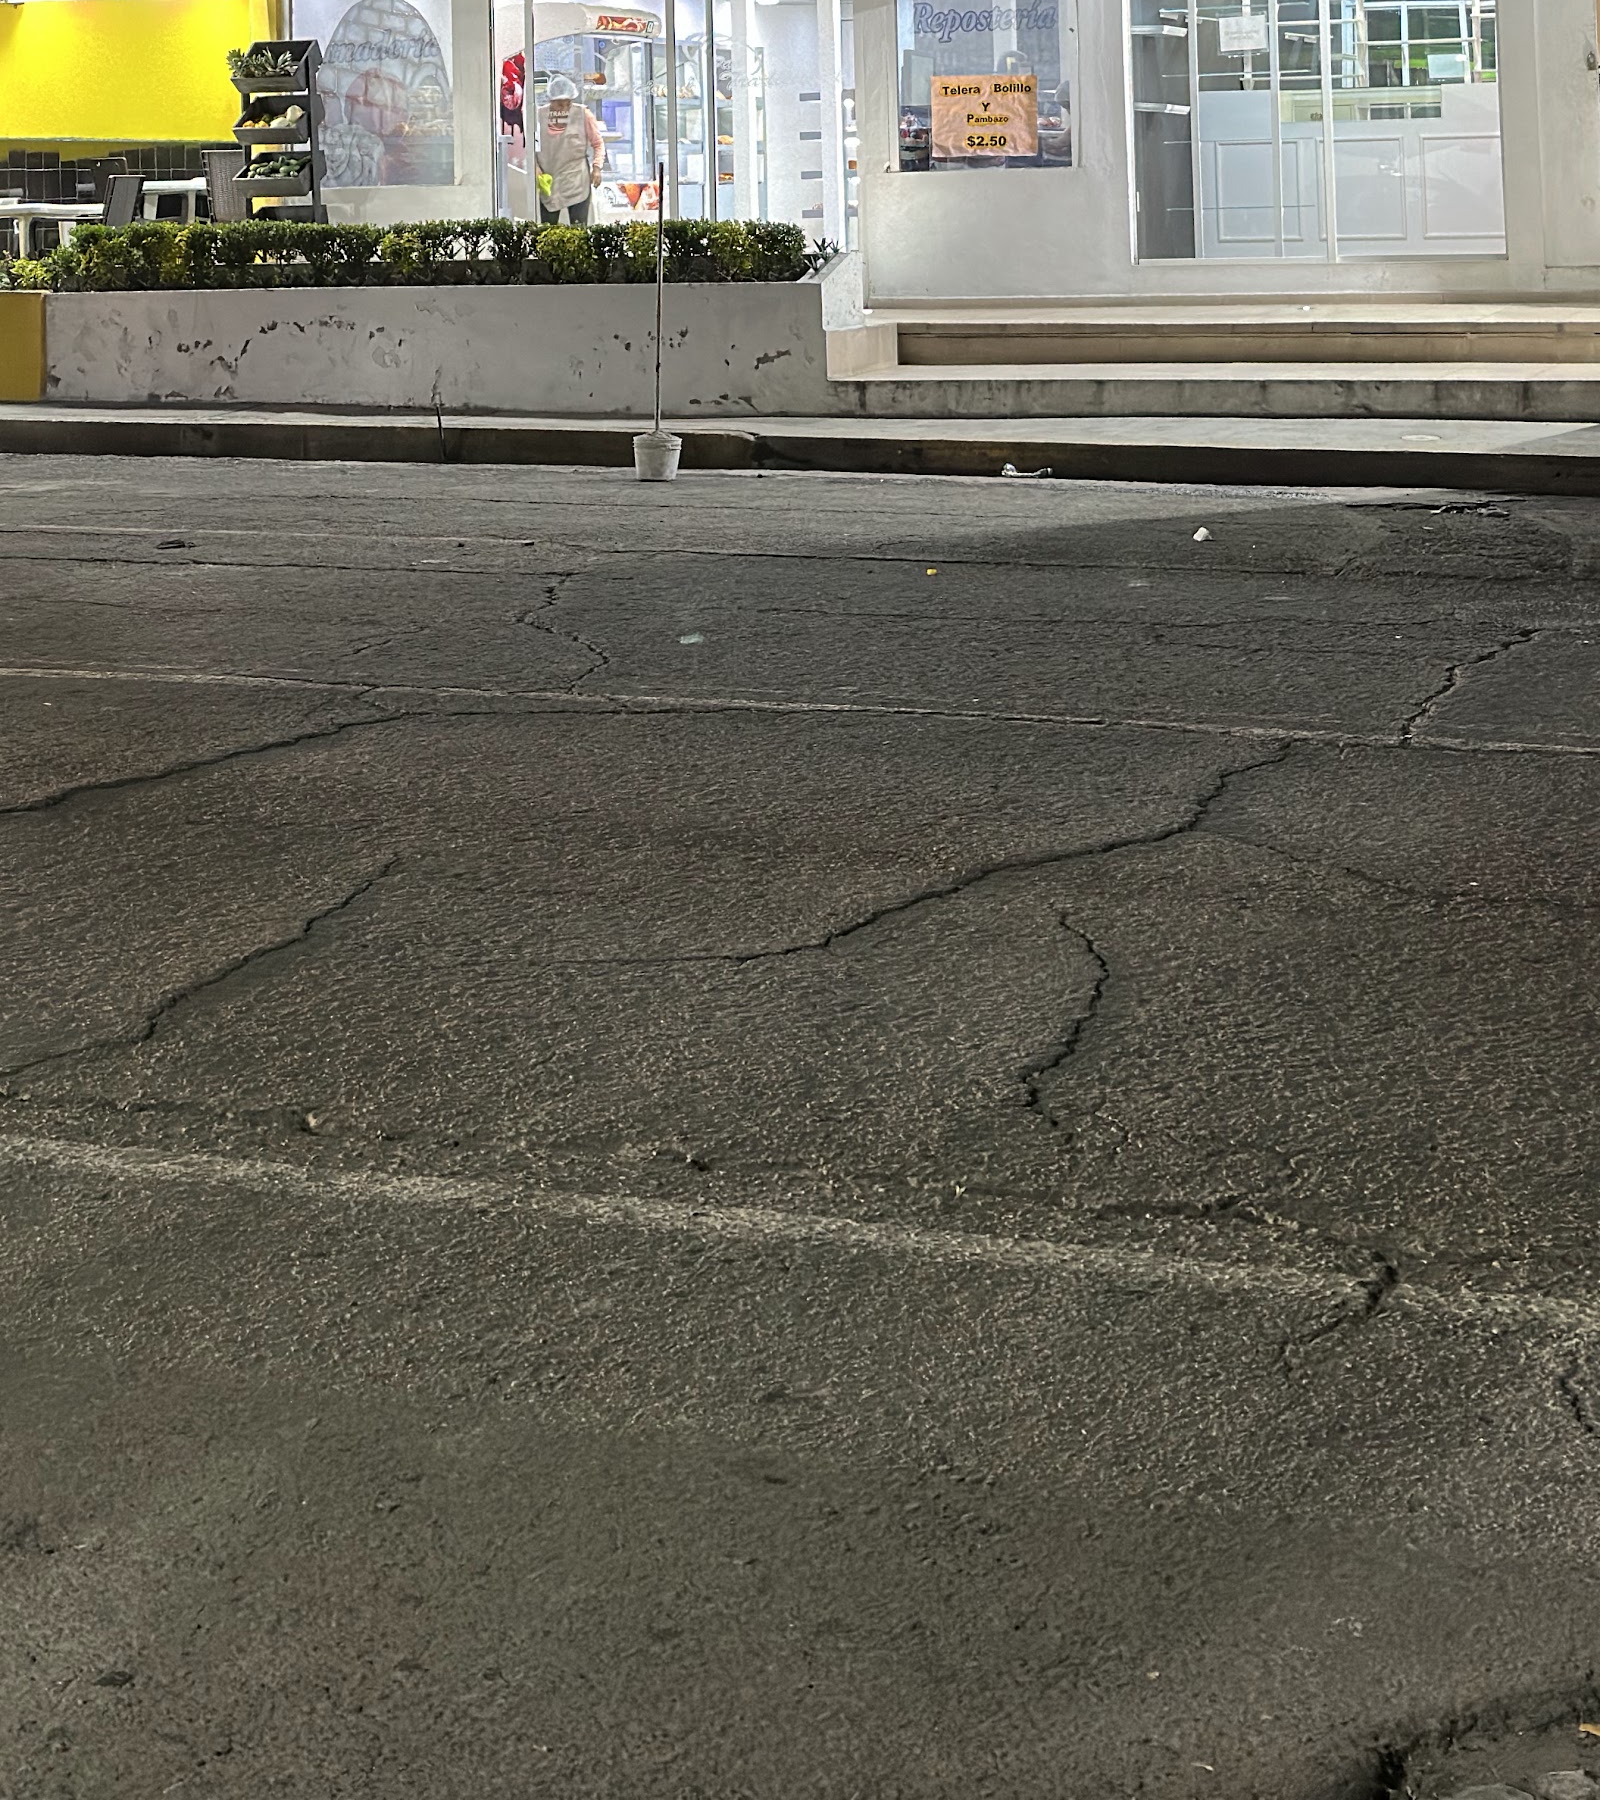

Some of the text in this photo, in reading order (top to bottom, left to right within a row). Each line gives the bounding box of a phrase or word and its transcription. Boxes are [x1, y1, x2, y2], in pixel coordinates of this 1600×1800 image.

[942, 83, 1032, 95] Telera Bolillo
[981, 102, 991, 112] Y
[966, 113, 1009, 123] Pambazo
[967, 135, 1007, 147] $2.50
